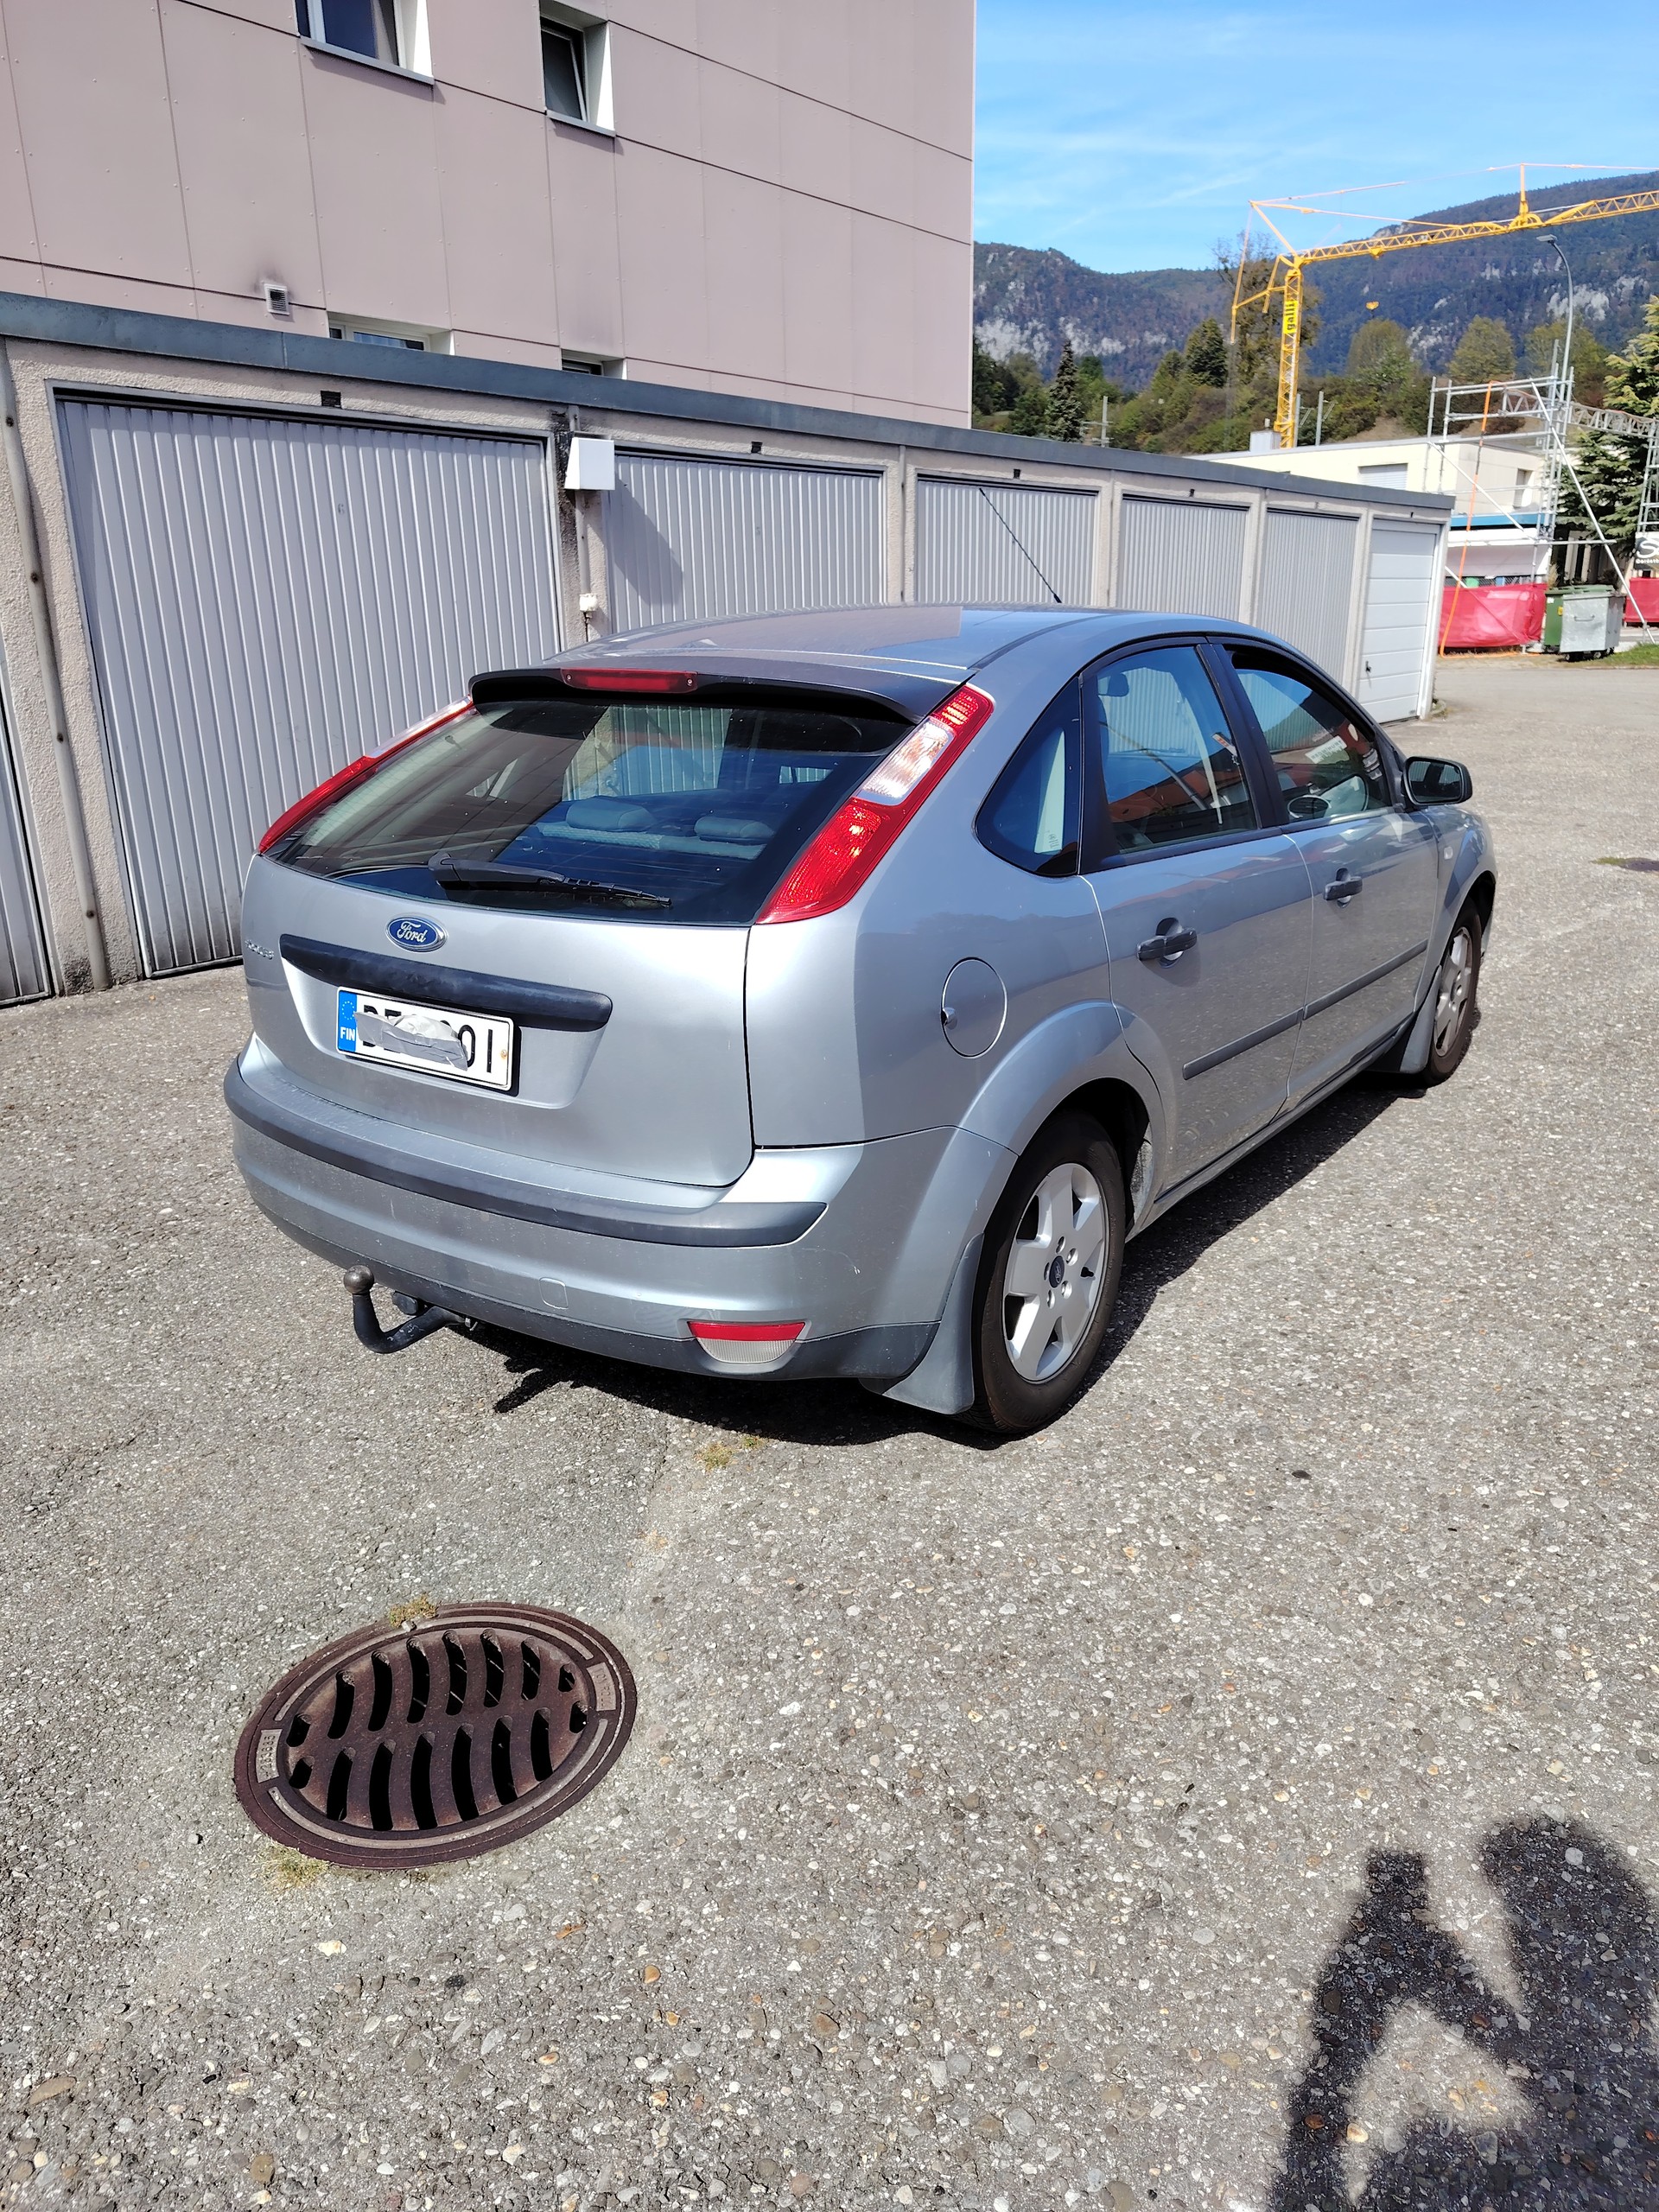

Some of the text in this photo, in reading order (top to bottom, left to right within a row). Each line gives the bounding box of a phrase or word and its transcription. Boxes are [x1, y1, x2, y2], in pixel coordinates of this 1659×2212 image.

[1285, 302, 1296, 331] galli
[397, 921, 428, 943] Ford
[340, 1026, 356, 1041] FIN
